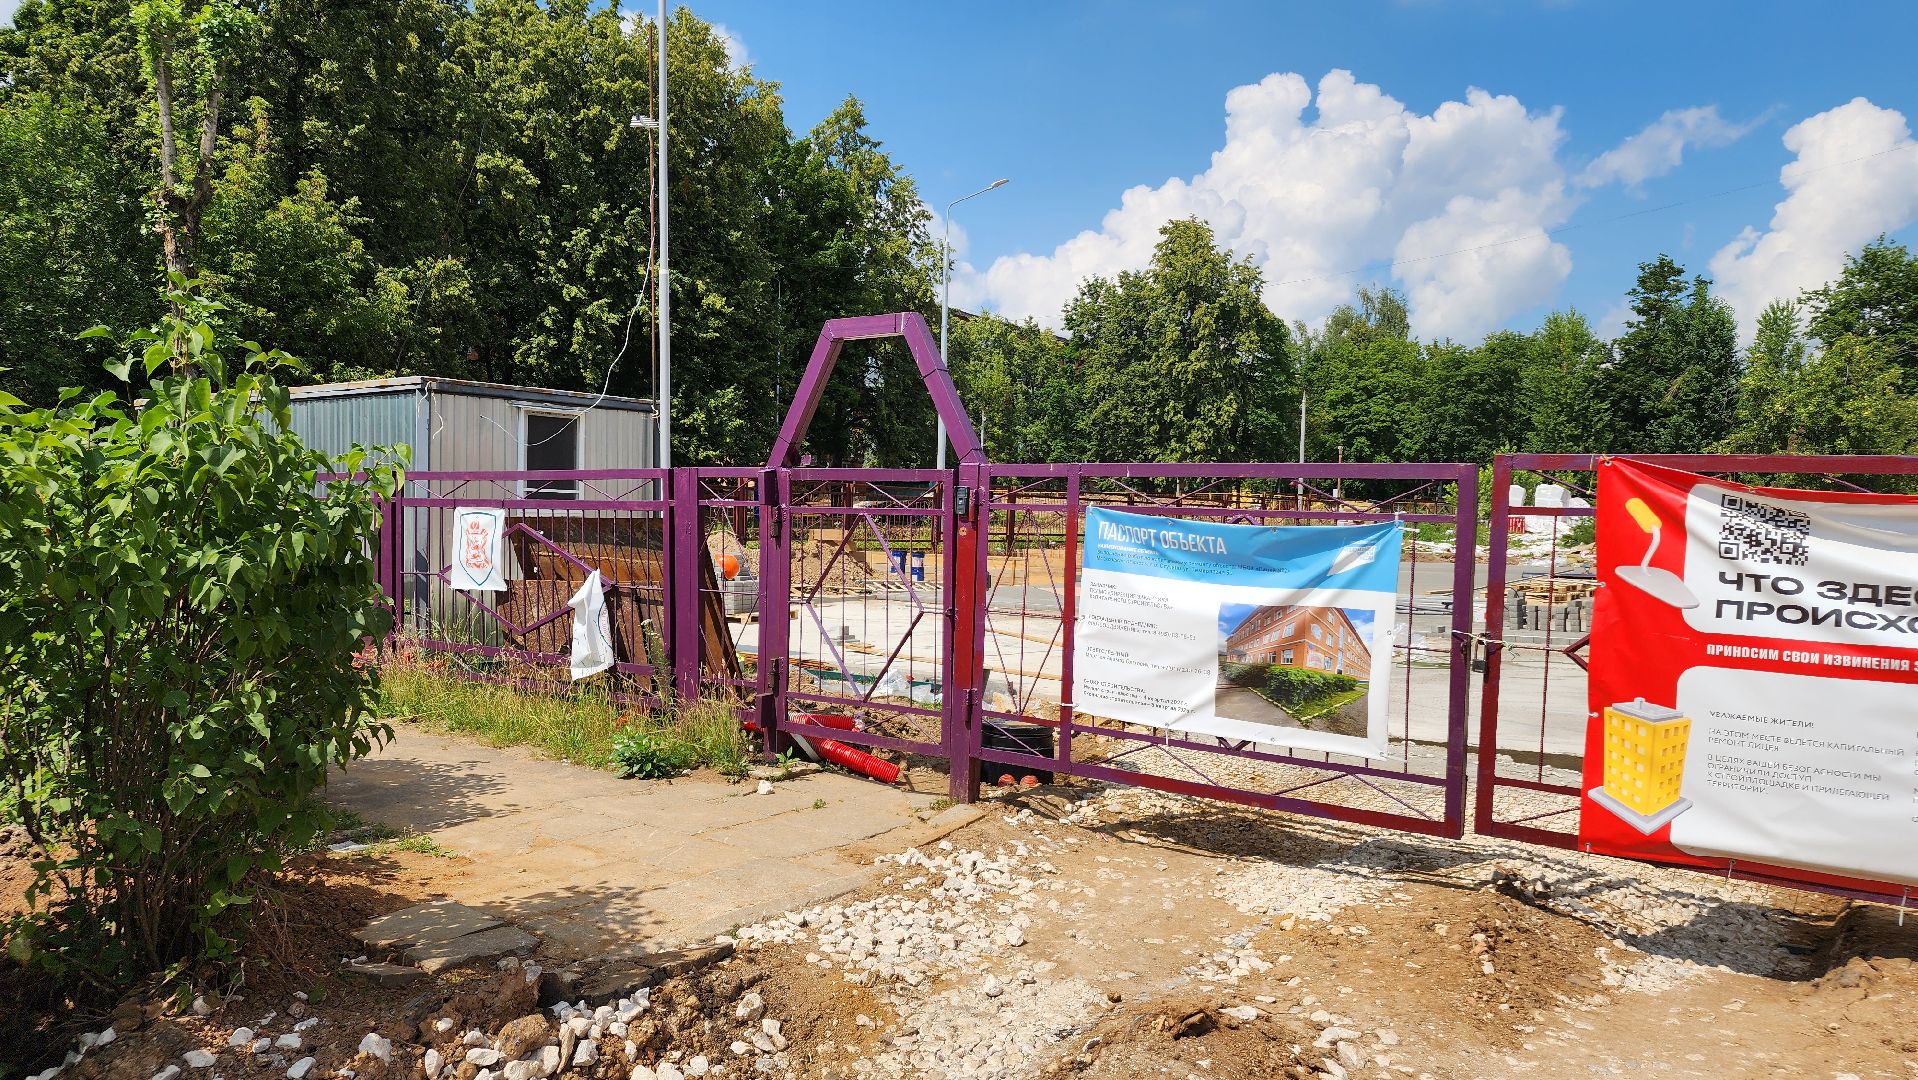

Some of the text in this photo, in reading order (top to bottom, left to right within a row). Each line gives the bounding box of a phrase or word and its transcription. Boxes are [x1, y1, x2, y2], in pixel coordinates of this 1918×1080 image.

[1098, 521, 1227, 555] ПАСПОРТ ОБЪЕКТА
[1718, 571, 1918, 607] ЧТО ЗДЕ
[1706, 643, 1779, 661] ПРИНОСИМ
[1782, 650, 1820, 665] СВОИ
[1823, 653, 1910, 671] ИЗВИНЕНИЯ
[1709, 710, 1814, 729] УВАЖАЕМЫЕ ЖИТЕЛИ!
[1708, 727, 1721, 735] НА
[1723, 729, 1750, 740] ЭТОМ
[1751, 733, 1781, 743] МЕСТЕ
[1708, 736, 1745, 748] РЕМОНТ
[1707, 762, 1812, 783] ОГРАНИЧИЛИ ДОСТУП
[1715, 754, 1745, 765] ЦЕЛЯХ
[1746, 759, 1780, 770] ВАШЕЙ
[1782, 763, 1861, 779] БЕЗОПАСНОСТИ
[1863, 773, 1882, 782] МЫ
[1714, 772, 1800, 790] СТРОЙПЛОЩАДКЕ
